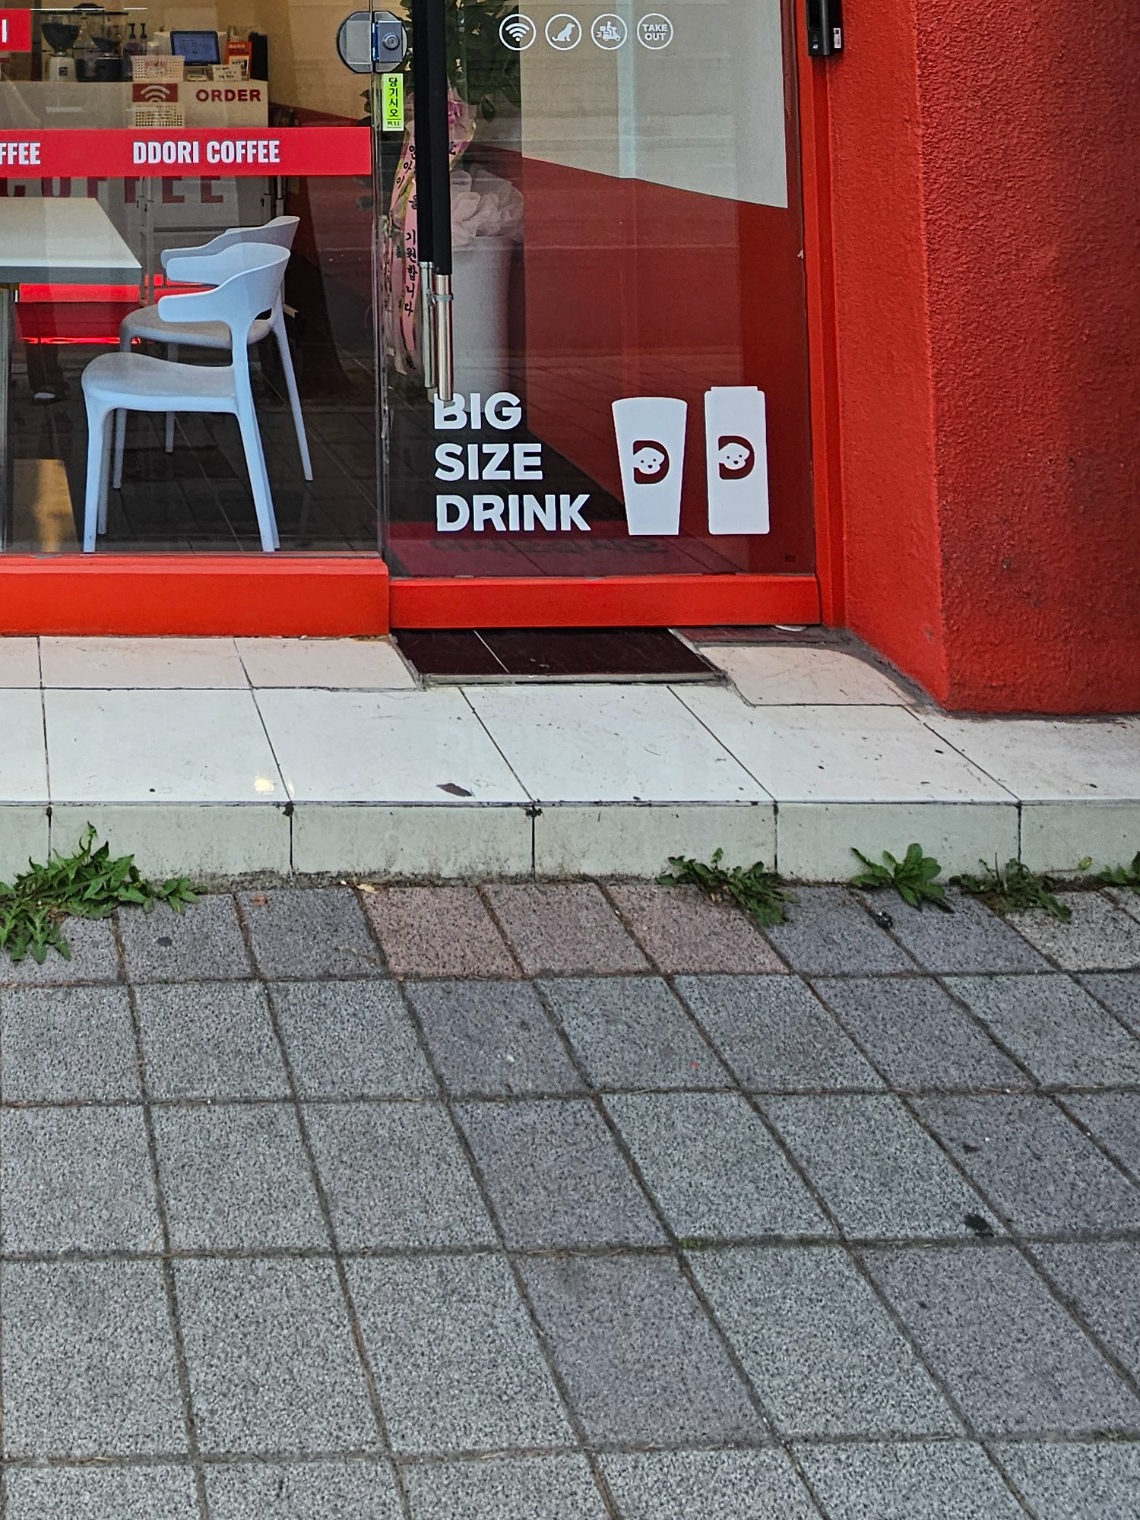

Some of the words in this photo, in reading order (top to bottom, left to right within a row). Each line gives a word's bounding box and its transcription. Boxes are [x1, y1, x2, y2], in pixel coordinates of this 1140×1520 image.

[642, 23, 668, 32] TAKE
[644, 32, 667, 42] OUT
[195, 88, 262, 102] ORDER
[388, 76, 399, 118] 당기시오
[132, 141, 200, 164] DDORI
[206, 139, 281, 163] COFFEE
[432, 391, 523, 431] BIG
[433, 442, 544, 481] SIZE
[436, 493, 591, 532] DRINK
